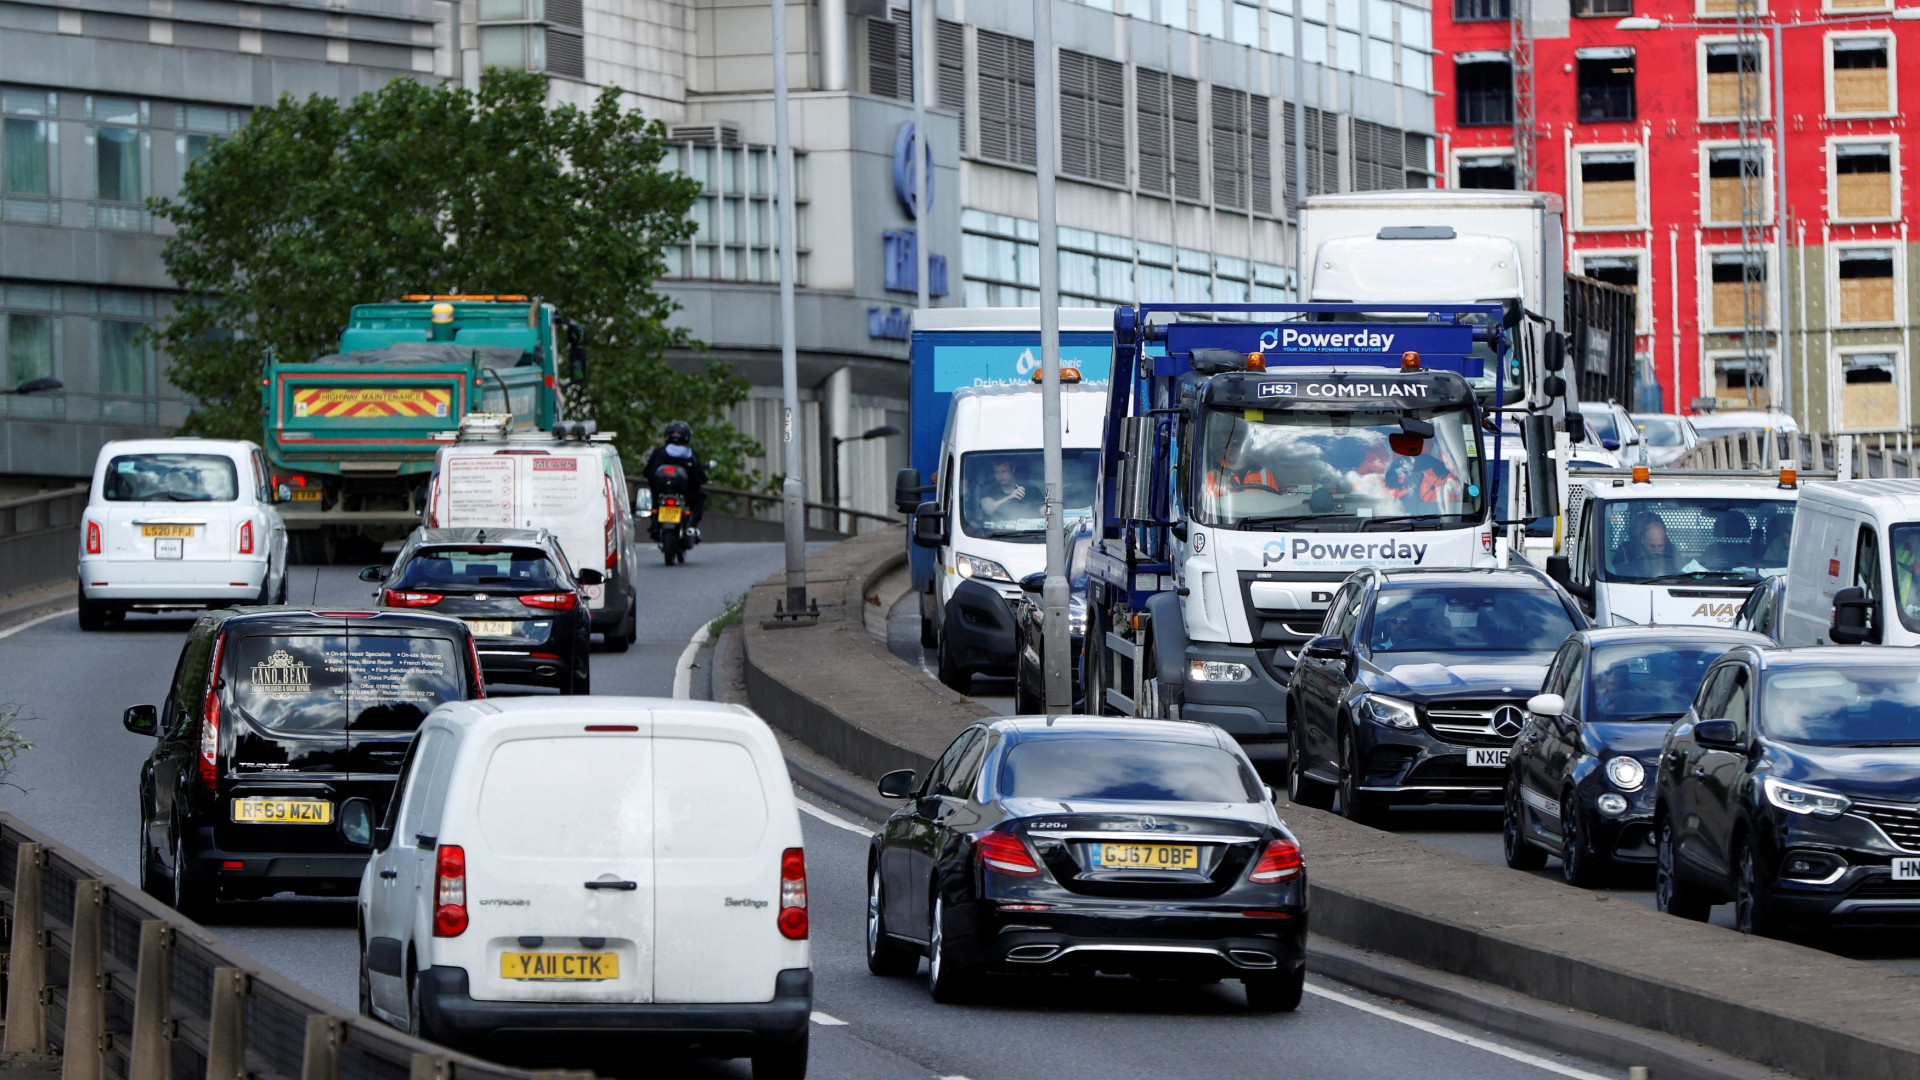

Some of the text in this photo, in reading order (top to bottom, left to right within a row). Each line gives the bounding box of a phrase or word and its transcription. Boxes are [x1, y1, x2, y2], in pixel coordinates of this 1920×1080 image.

[1283, 328, 1395, 352] Powerday
[1009, 377, 1035, 386] Wat
[321, 393, 422, 401] HIGHWAY MAINTENANCE
[1262, 383, 1429, 398] HS2 COMPLIANT
[536, 460, 574, 468] MEARS
[145, 525, 192, 536] LS20 FFJ
[1292, 538, 1428, 565] Powerday
[483, 622, 505, 633] AZN
[252, 668, 278, 684] CANO
[283, 667, 309, 684] BEAN
[1476, 750, 1509, 764] NX16
[242, 802, 323, 820] RF69 MZN
[1105, 846, 1194, 865] GJ67 OBF
[724, 897, 769, 909] Berlingo
[520, 955, 602, 975] YA11 CTK
